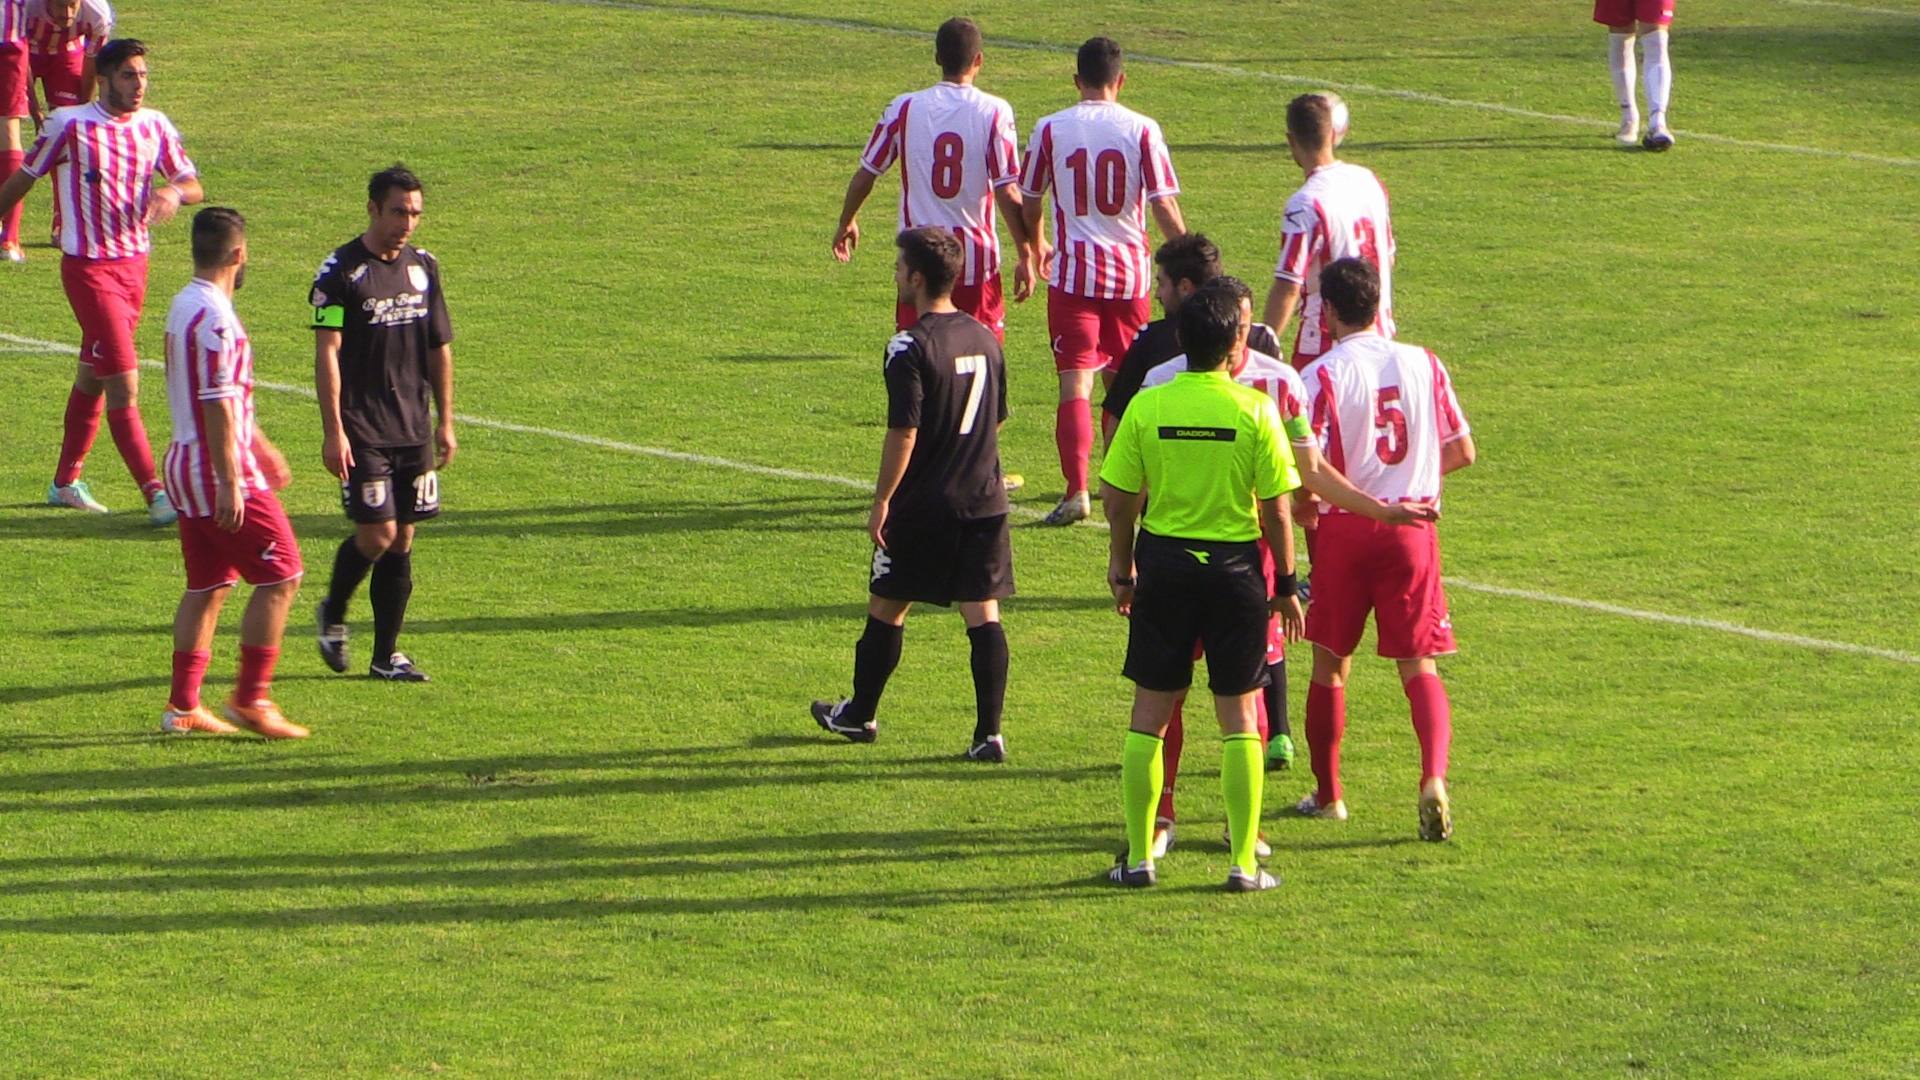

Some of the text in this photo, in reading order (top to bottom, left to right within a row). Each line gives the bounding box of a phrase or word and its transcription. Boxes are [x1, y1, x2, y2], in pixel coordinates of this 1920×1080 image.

[931, 131, 964, 199] 8
[1066, 147, 1126, 217] 10
[954, 355, 988, 435] 7
[1374, 386, 1410, 466] 5
[1176, 430, 1217, 438] DIADORA
[412, 470, 438, 505] 10
